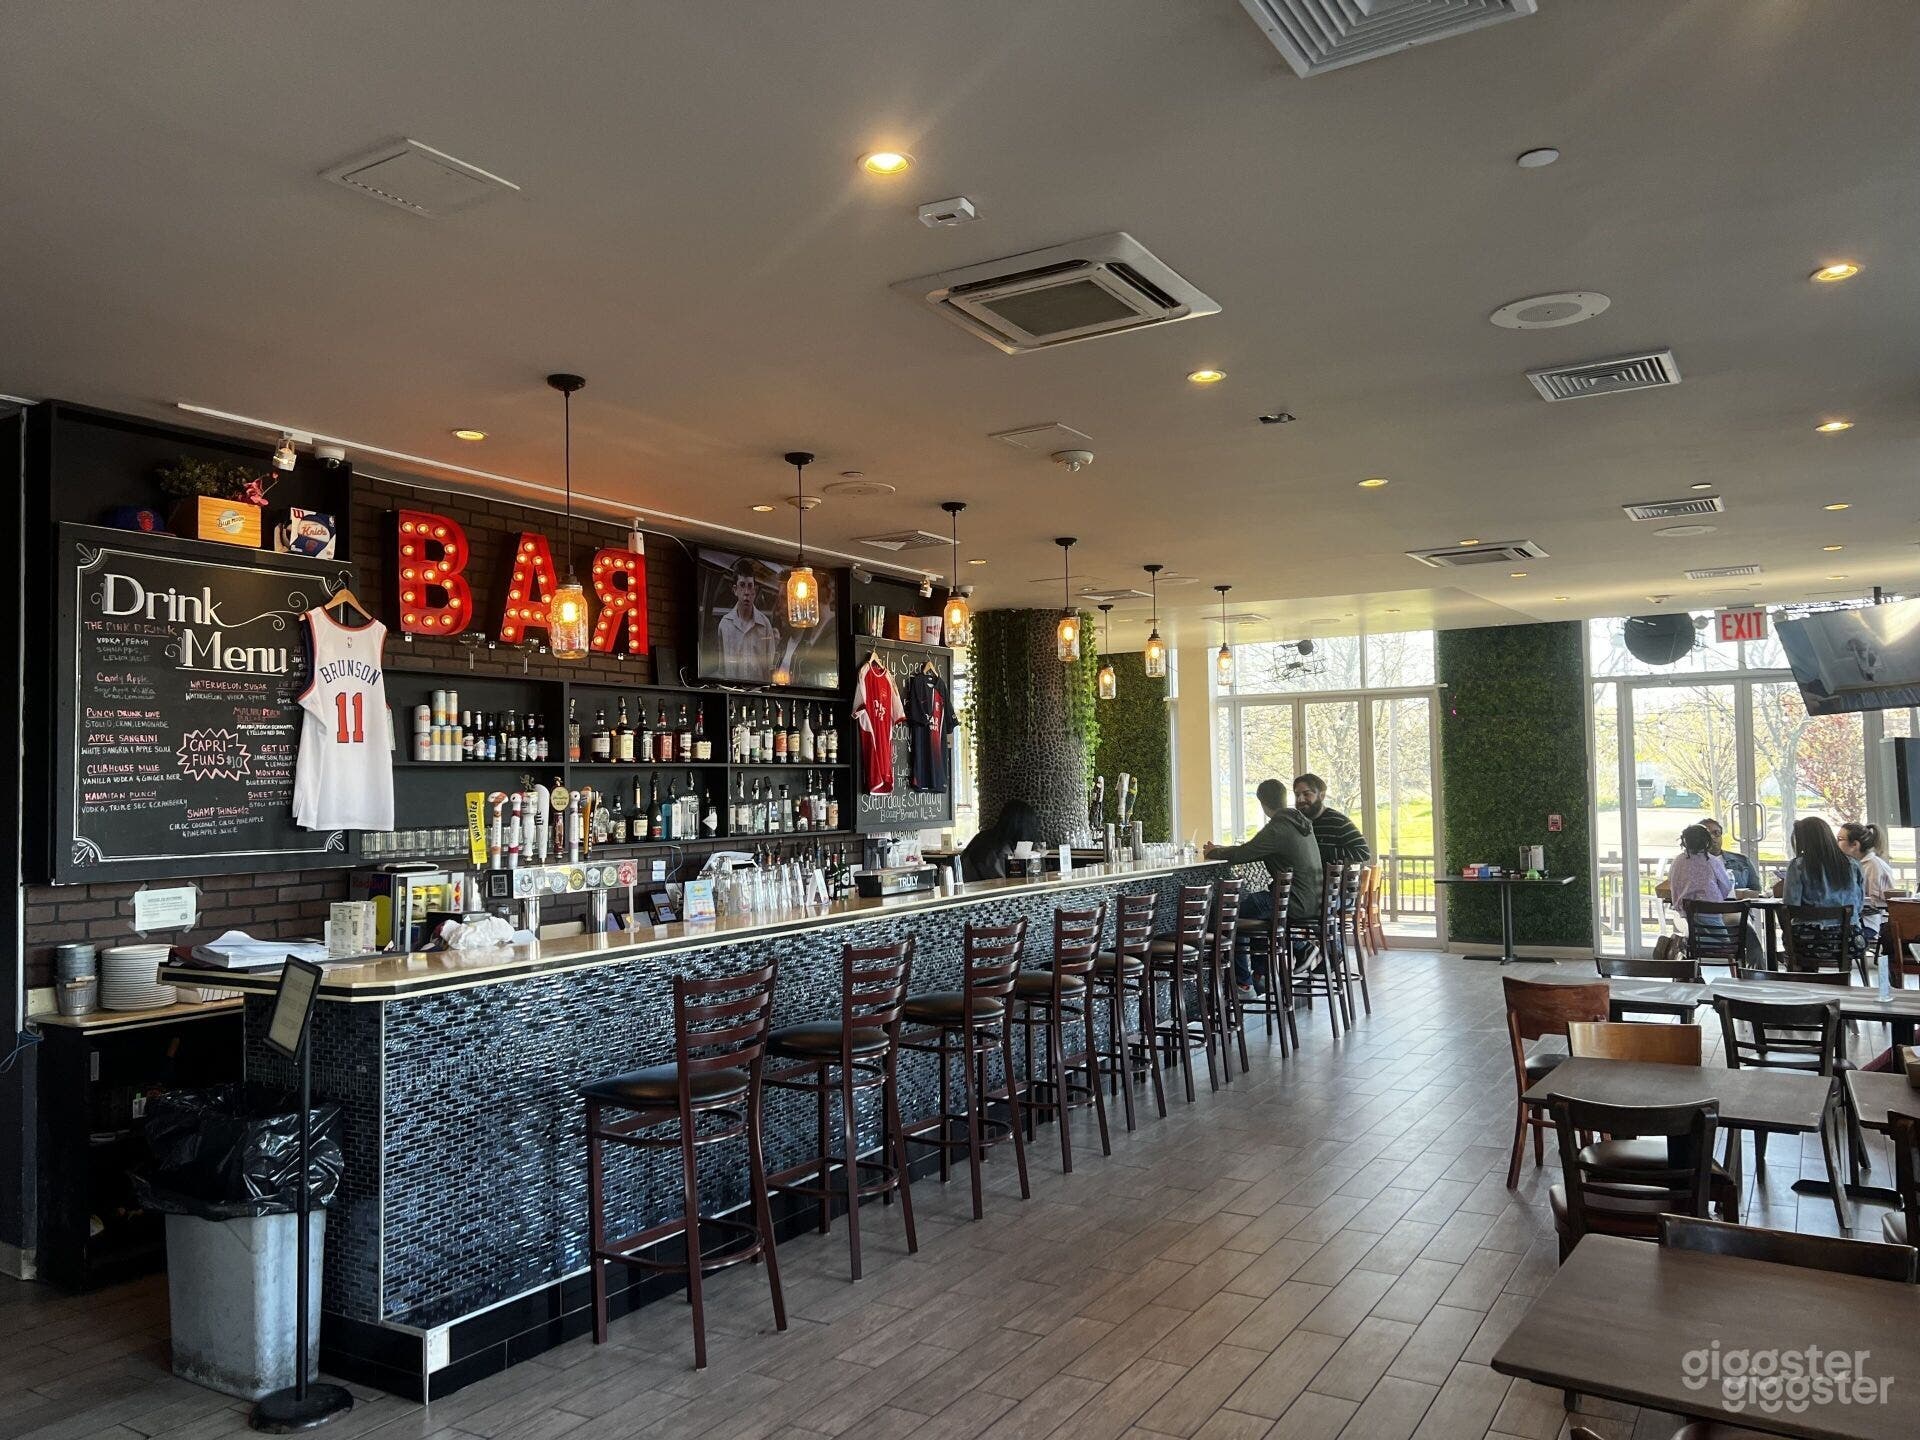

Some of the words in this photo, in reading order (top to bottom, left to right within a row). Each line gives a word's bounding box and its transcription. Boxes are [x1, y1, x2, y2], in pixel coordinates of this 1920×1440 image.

[102, 573, 224, 627] Drink
[84, 621, 103, 631] THE
[1721, 612, 1764, 640] EXIT
[182, 629, 289, 673] Menu
[319, 659, 381, 686] BRUNSON
[190, 680, 241, 691] WATERMELON
[243, 683, 267, 691] SUGAR
[86, 707, 114, 718] PUNCH
[117, 709, 142, 717] DRUNK
[335, 691, 364, 744] 11
[88, 734, 115, 743] APPLE
[118, 734, 158, 743] SANGRINI
[102, 746, 129, 755] SANGRIA
[189, 740, 234, 753] CAPRI-
[192, 753, 225, 767] FUNS
[86, 764, 135, 774] CLUBHOUSE
[138, 764, 160, 772] MULE
[255, 769, 291, 777] MONTAUK
[82, 776, 112, 785] VANILLA
[141, 774, 164, 782] GINGER
[129, 790, 157, 798] PUNCH
[187, 807, 215, 819] SWAMP
[470, 813, 482, 842] TWISTED
